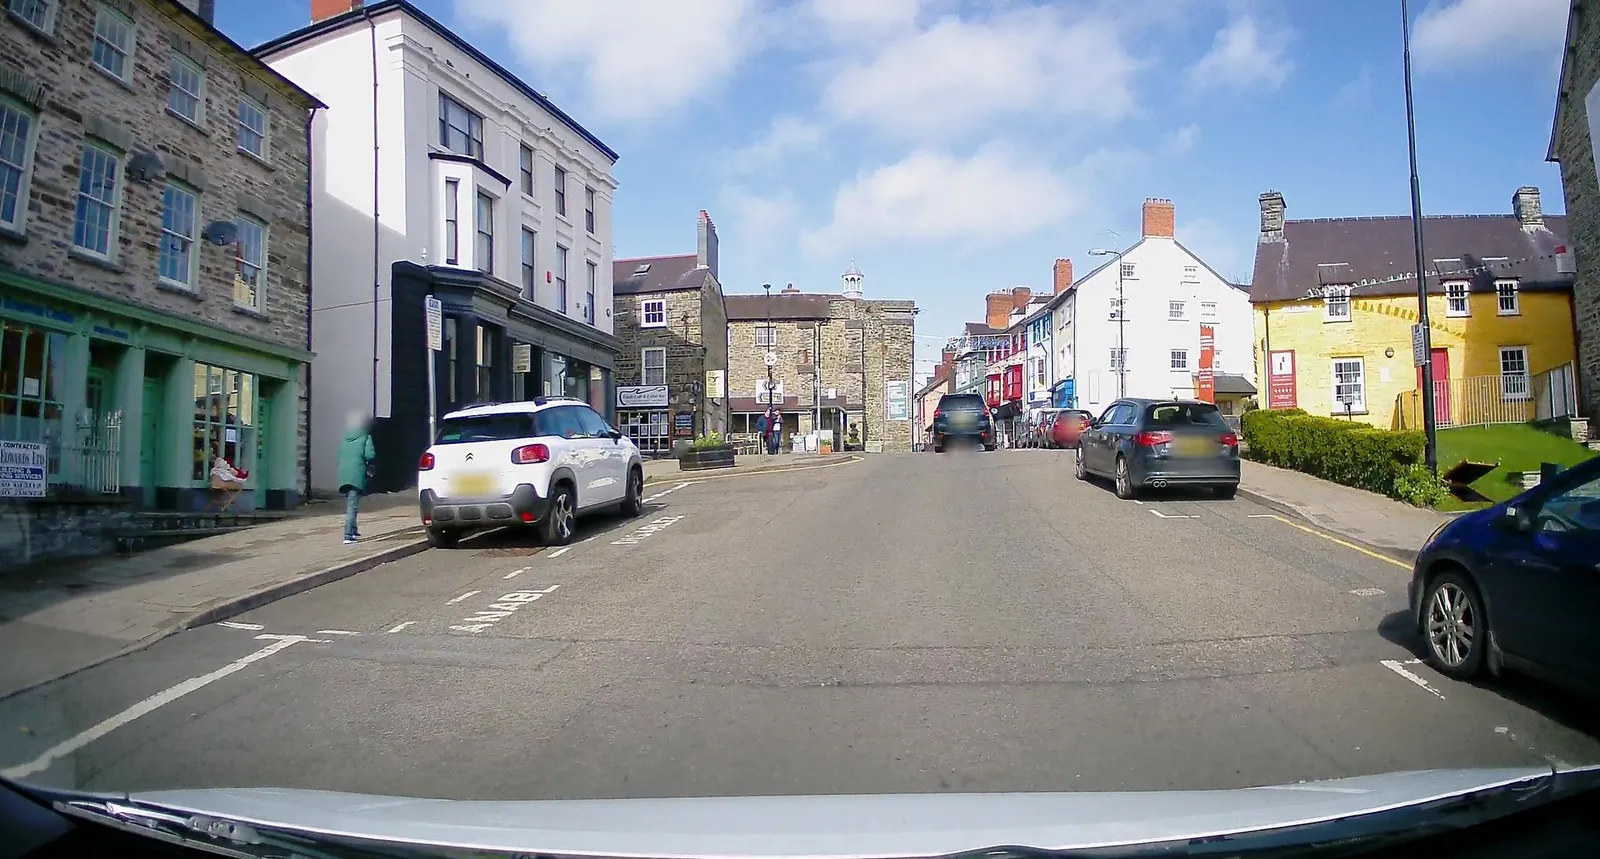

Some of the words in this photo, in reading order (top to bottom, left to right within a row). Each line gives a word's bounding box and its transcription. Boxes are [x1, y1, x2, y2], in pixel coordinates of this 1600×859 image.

[3, 442, 41, 450] CONTRACTOR
[32, 451, 45, 465] LTD
[14, 472, 42, 480] SERVICES
[449, 584, 562, 634] ANABL
